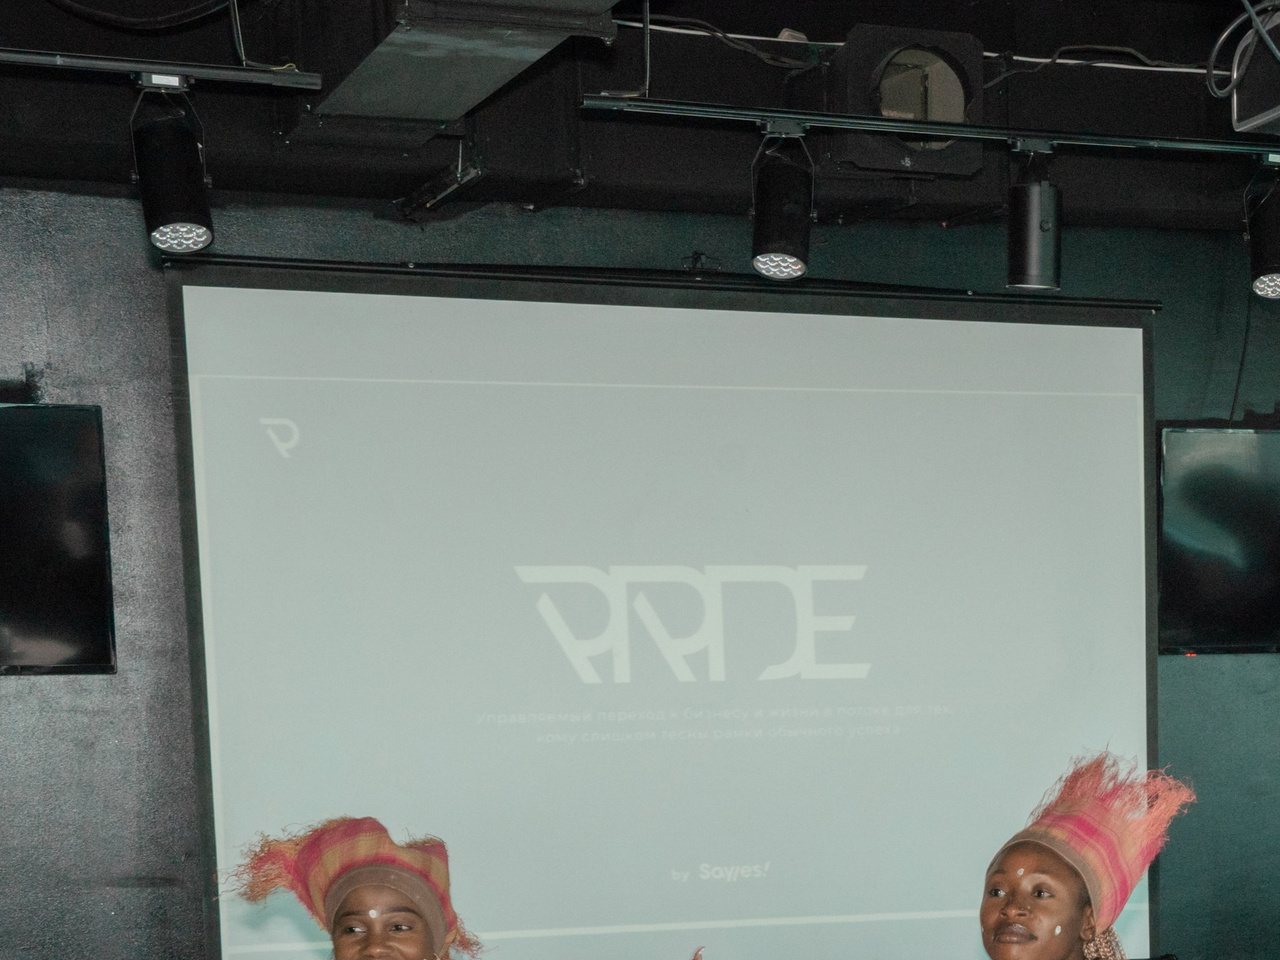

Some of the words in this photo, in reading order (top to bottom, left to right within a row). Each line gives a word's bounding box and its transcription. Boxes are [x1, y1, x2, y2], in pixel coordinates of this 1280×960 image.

[476, 710, 592, 727] Управляемый
[597, 709, 665, 723] переход
[683, 707, 748, 722] бизнесу
[768, 708, 820, 718] жизни
[836, 706, 890, 717] потоке
[581, 731, 656, 743] слишком
[661, 730, 708, 741] тесны
[713, 728, 763, 741] рамки
[768, 725, 844, 738] обычного
[671, 869, 690, 881] by
